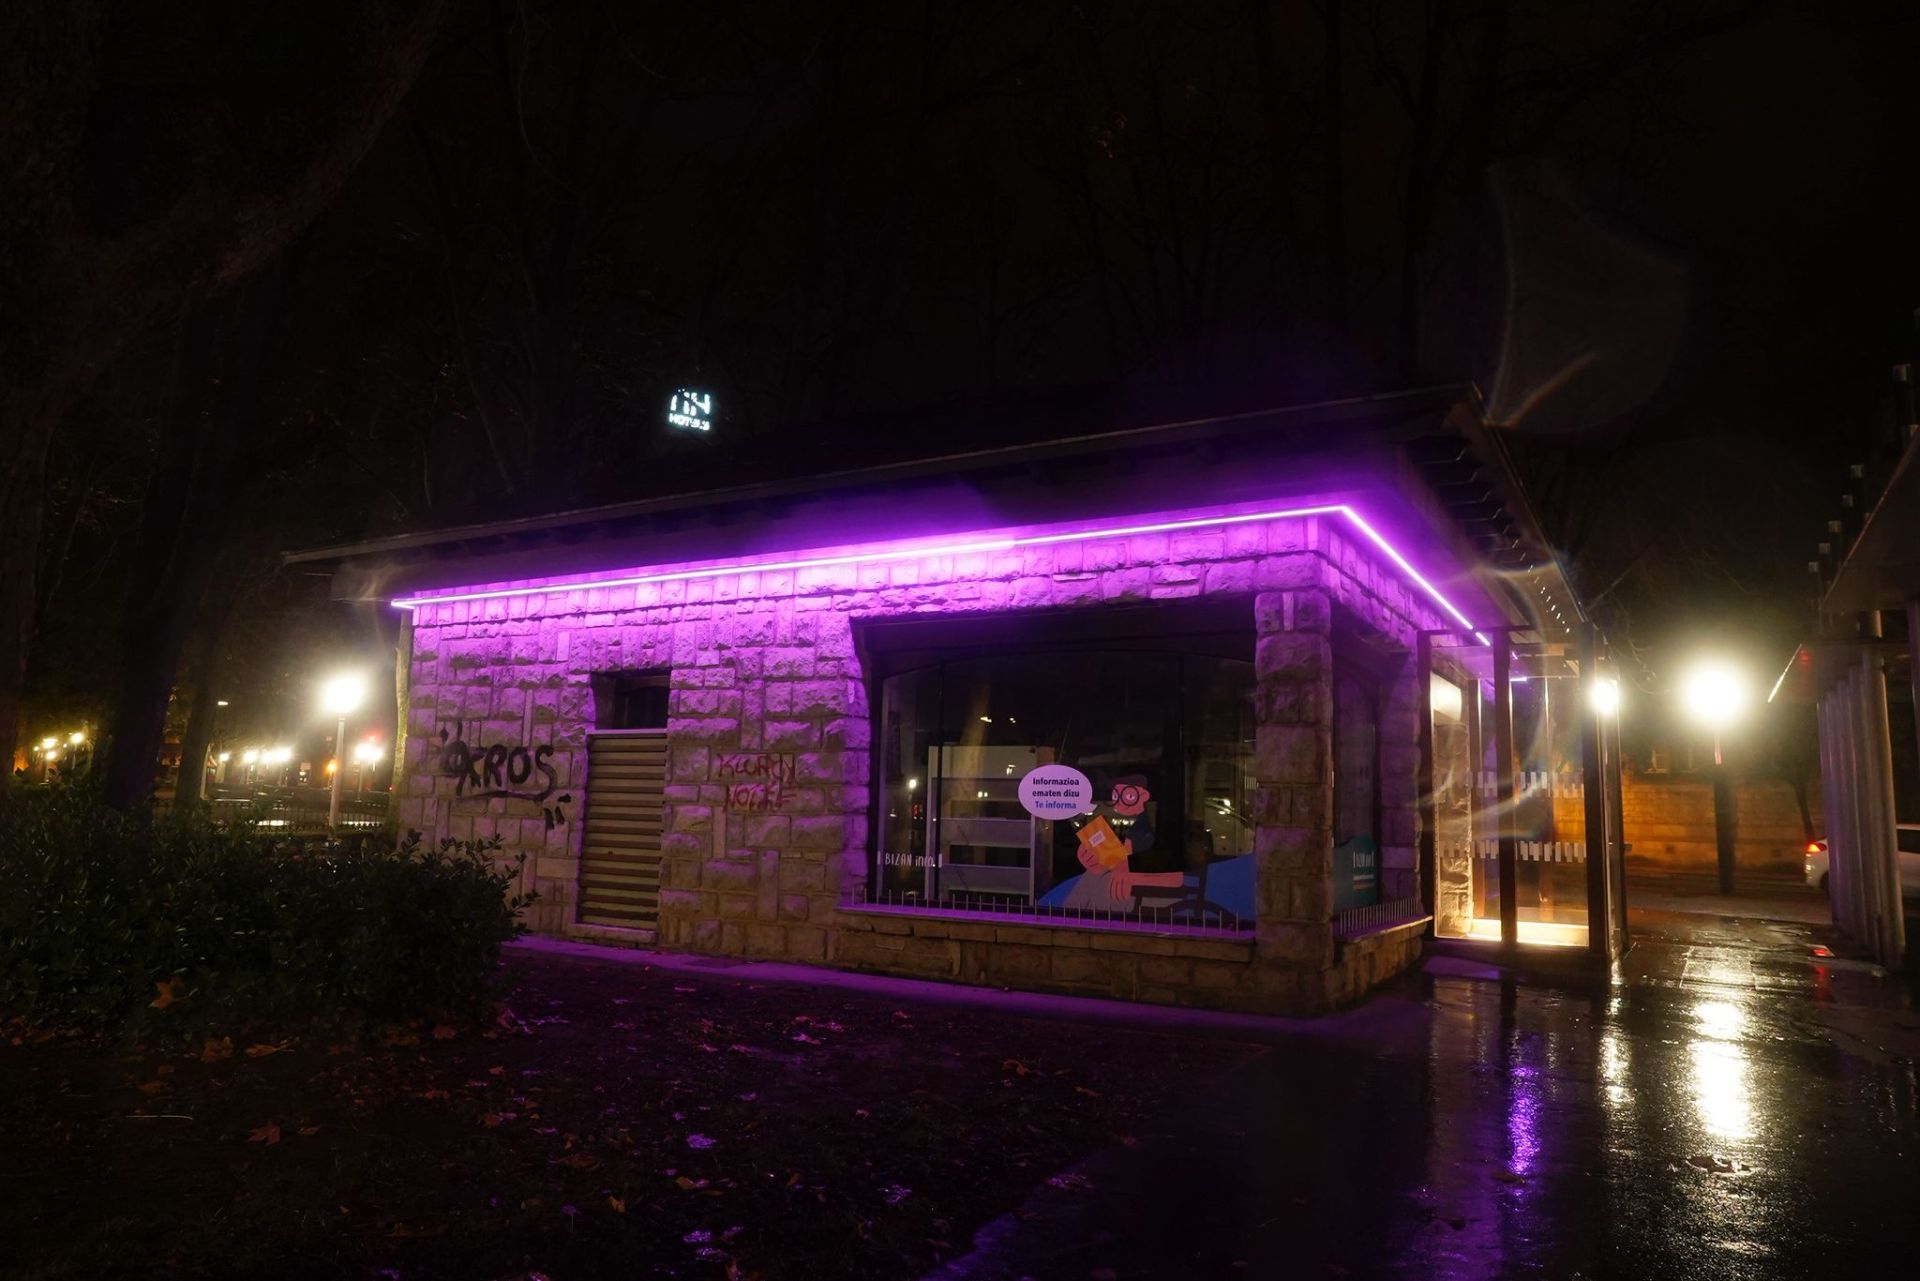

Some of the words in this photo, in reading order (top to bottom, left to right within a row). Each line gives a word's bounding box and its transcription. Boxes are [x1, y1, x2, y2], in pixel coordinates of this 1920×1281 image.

[1033, 777, 1079, 786] Informazioa
[1063, 789, 1080, 797] dizu
[1035, 800, 1044, 808] Te
[1045, 801, 1077, 809] informa
[885, 853, 912, 866] BIZAN
